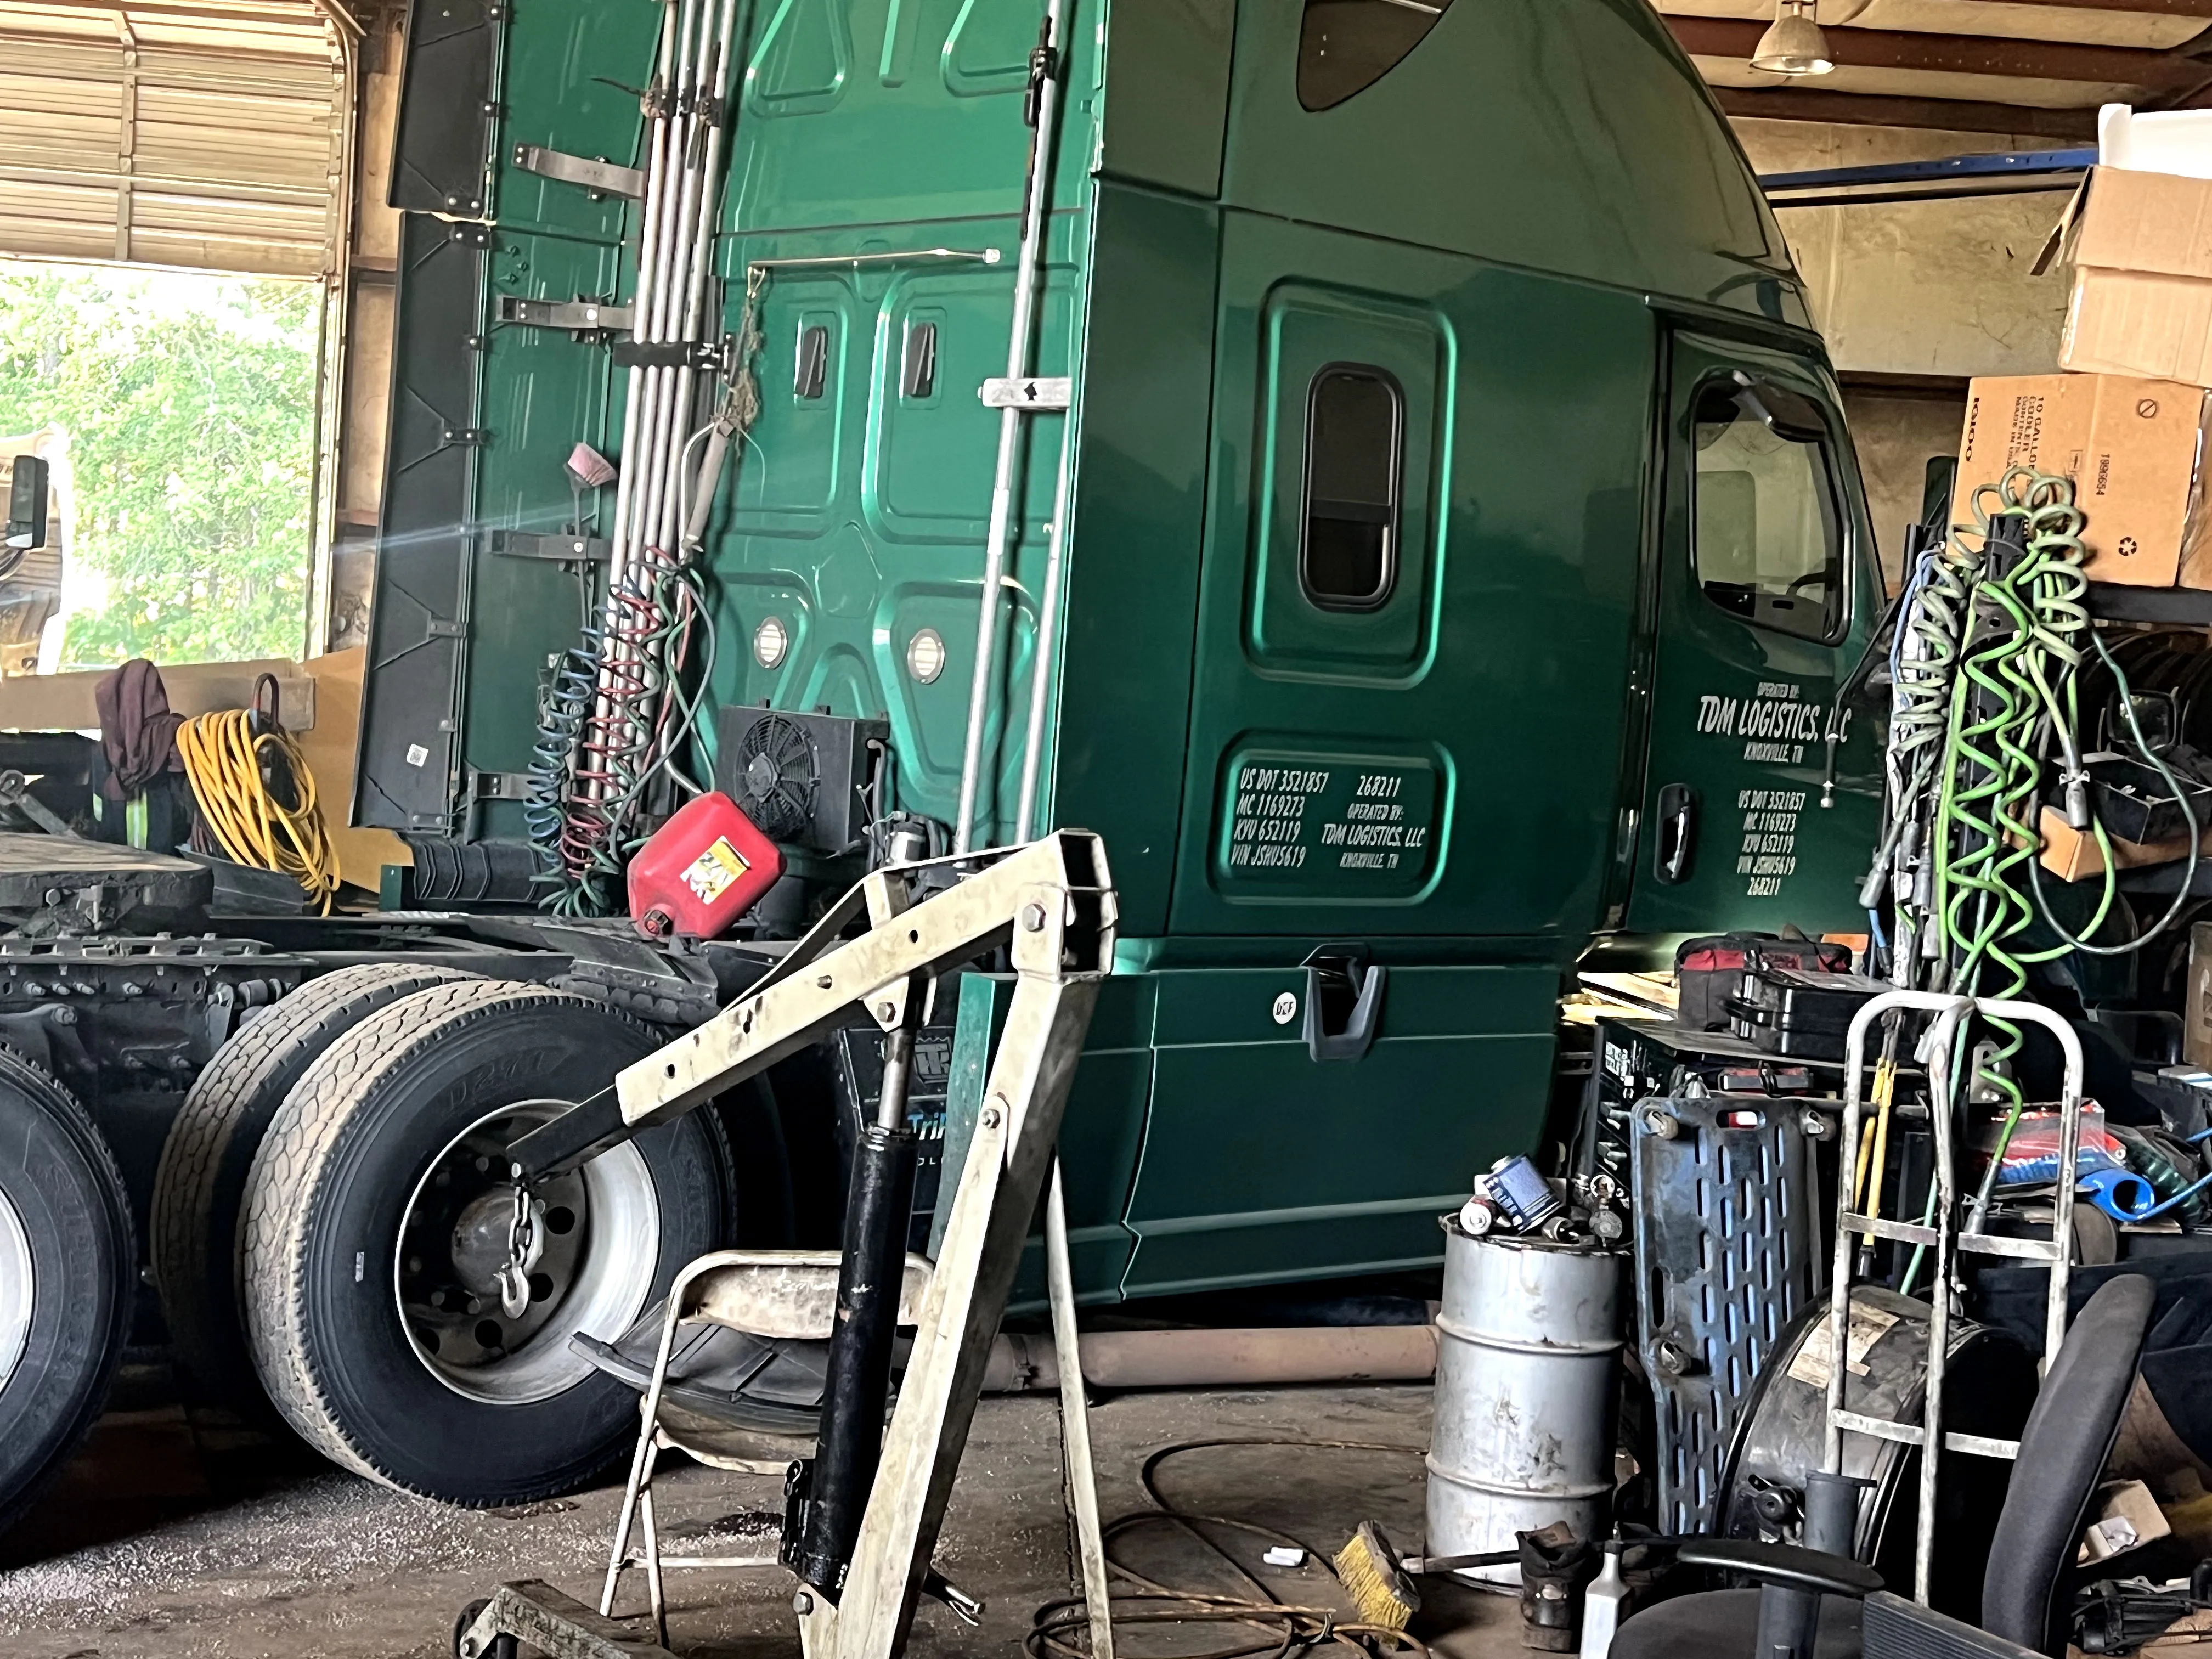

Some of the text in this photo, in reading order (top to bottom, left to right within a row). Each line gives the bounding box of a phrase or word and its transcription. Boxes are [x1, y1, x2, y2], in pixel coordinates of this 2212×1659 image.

[2036, 396, 2044, 413] 10
[2022, 396, 2036, 452] COOLER
[1697, 695, 1737, 736] TDM
[1737, 699, 1821, 743] LOGISTICS,
[1240, 768, 1329, 794] US DOT 3521857
[1356, 775, 1402, 798] 268211
[1236, 792, 1305, 817] MC 1169273
[1737, 789, 1751, 809] US
[1750, 789, 1769, 809] DOT
[1347, 803, 1389, 821] OPERATED
[1758, 812, 1797, 832] 1169273
[1233, 818, 1301, 843] KYU 652119
[1321, 823, 1347, 846] TDM
[1404, 827, 1426, 847] LLC
[1231, 843, 1252, 865] VIN
[1760, 833, 1795, 854] 652119
[1747, 877, 1781, 896] 268211
